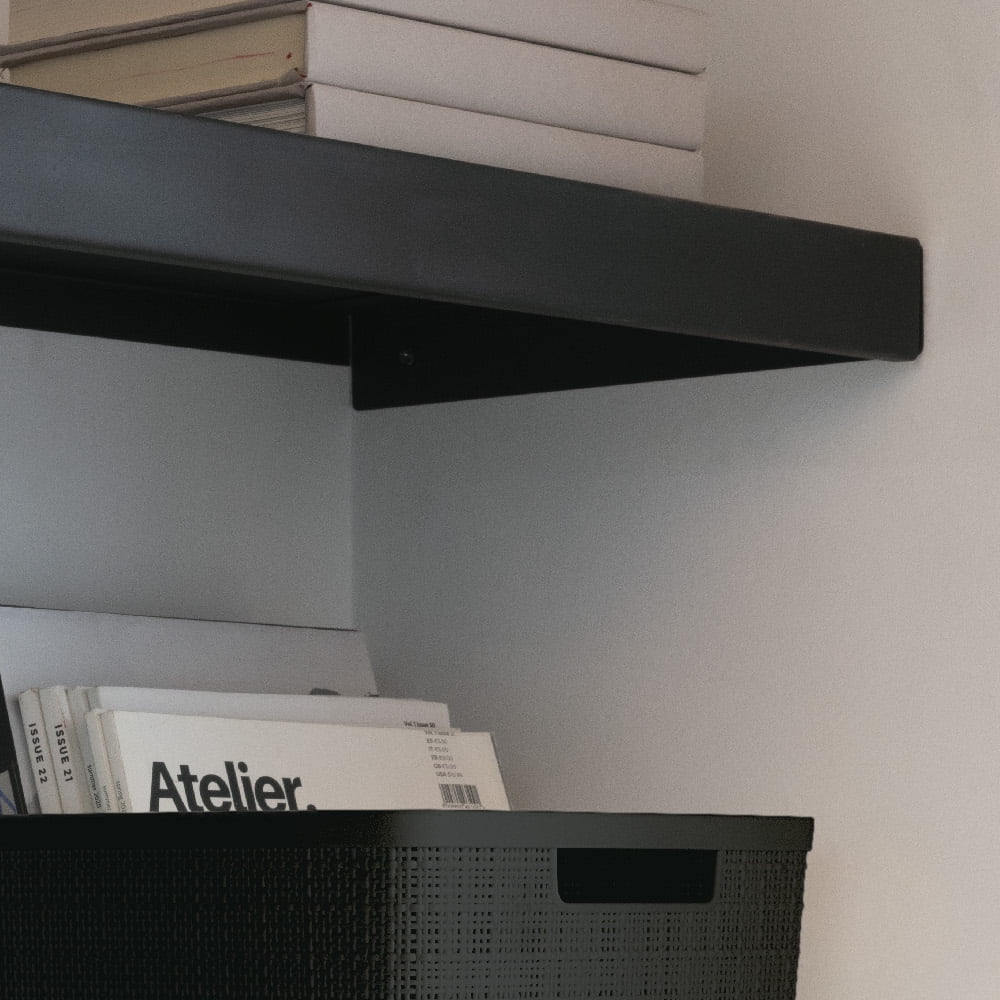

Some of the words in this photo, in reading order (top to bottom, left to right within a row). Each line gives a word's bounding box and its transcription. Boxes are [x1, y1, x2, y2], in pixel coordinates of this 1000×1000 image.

[28, 723, 44, 764] ISSUE
[38, 768, 48, 784] 22
[54, 724, 70, 764] ISSUE
[63, 768, 74, 782] 21
[149, 760, 317, 812] Atelier.
